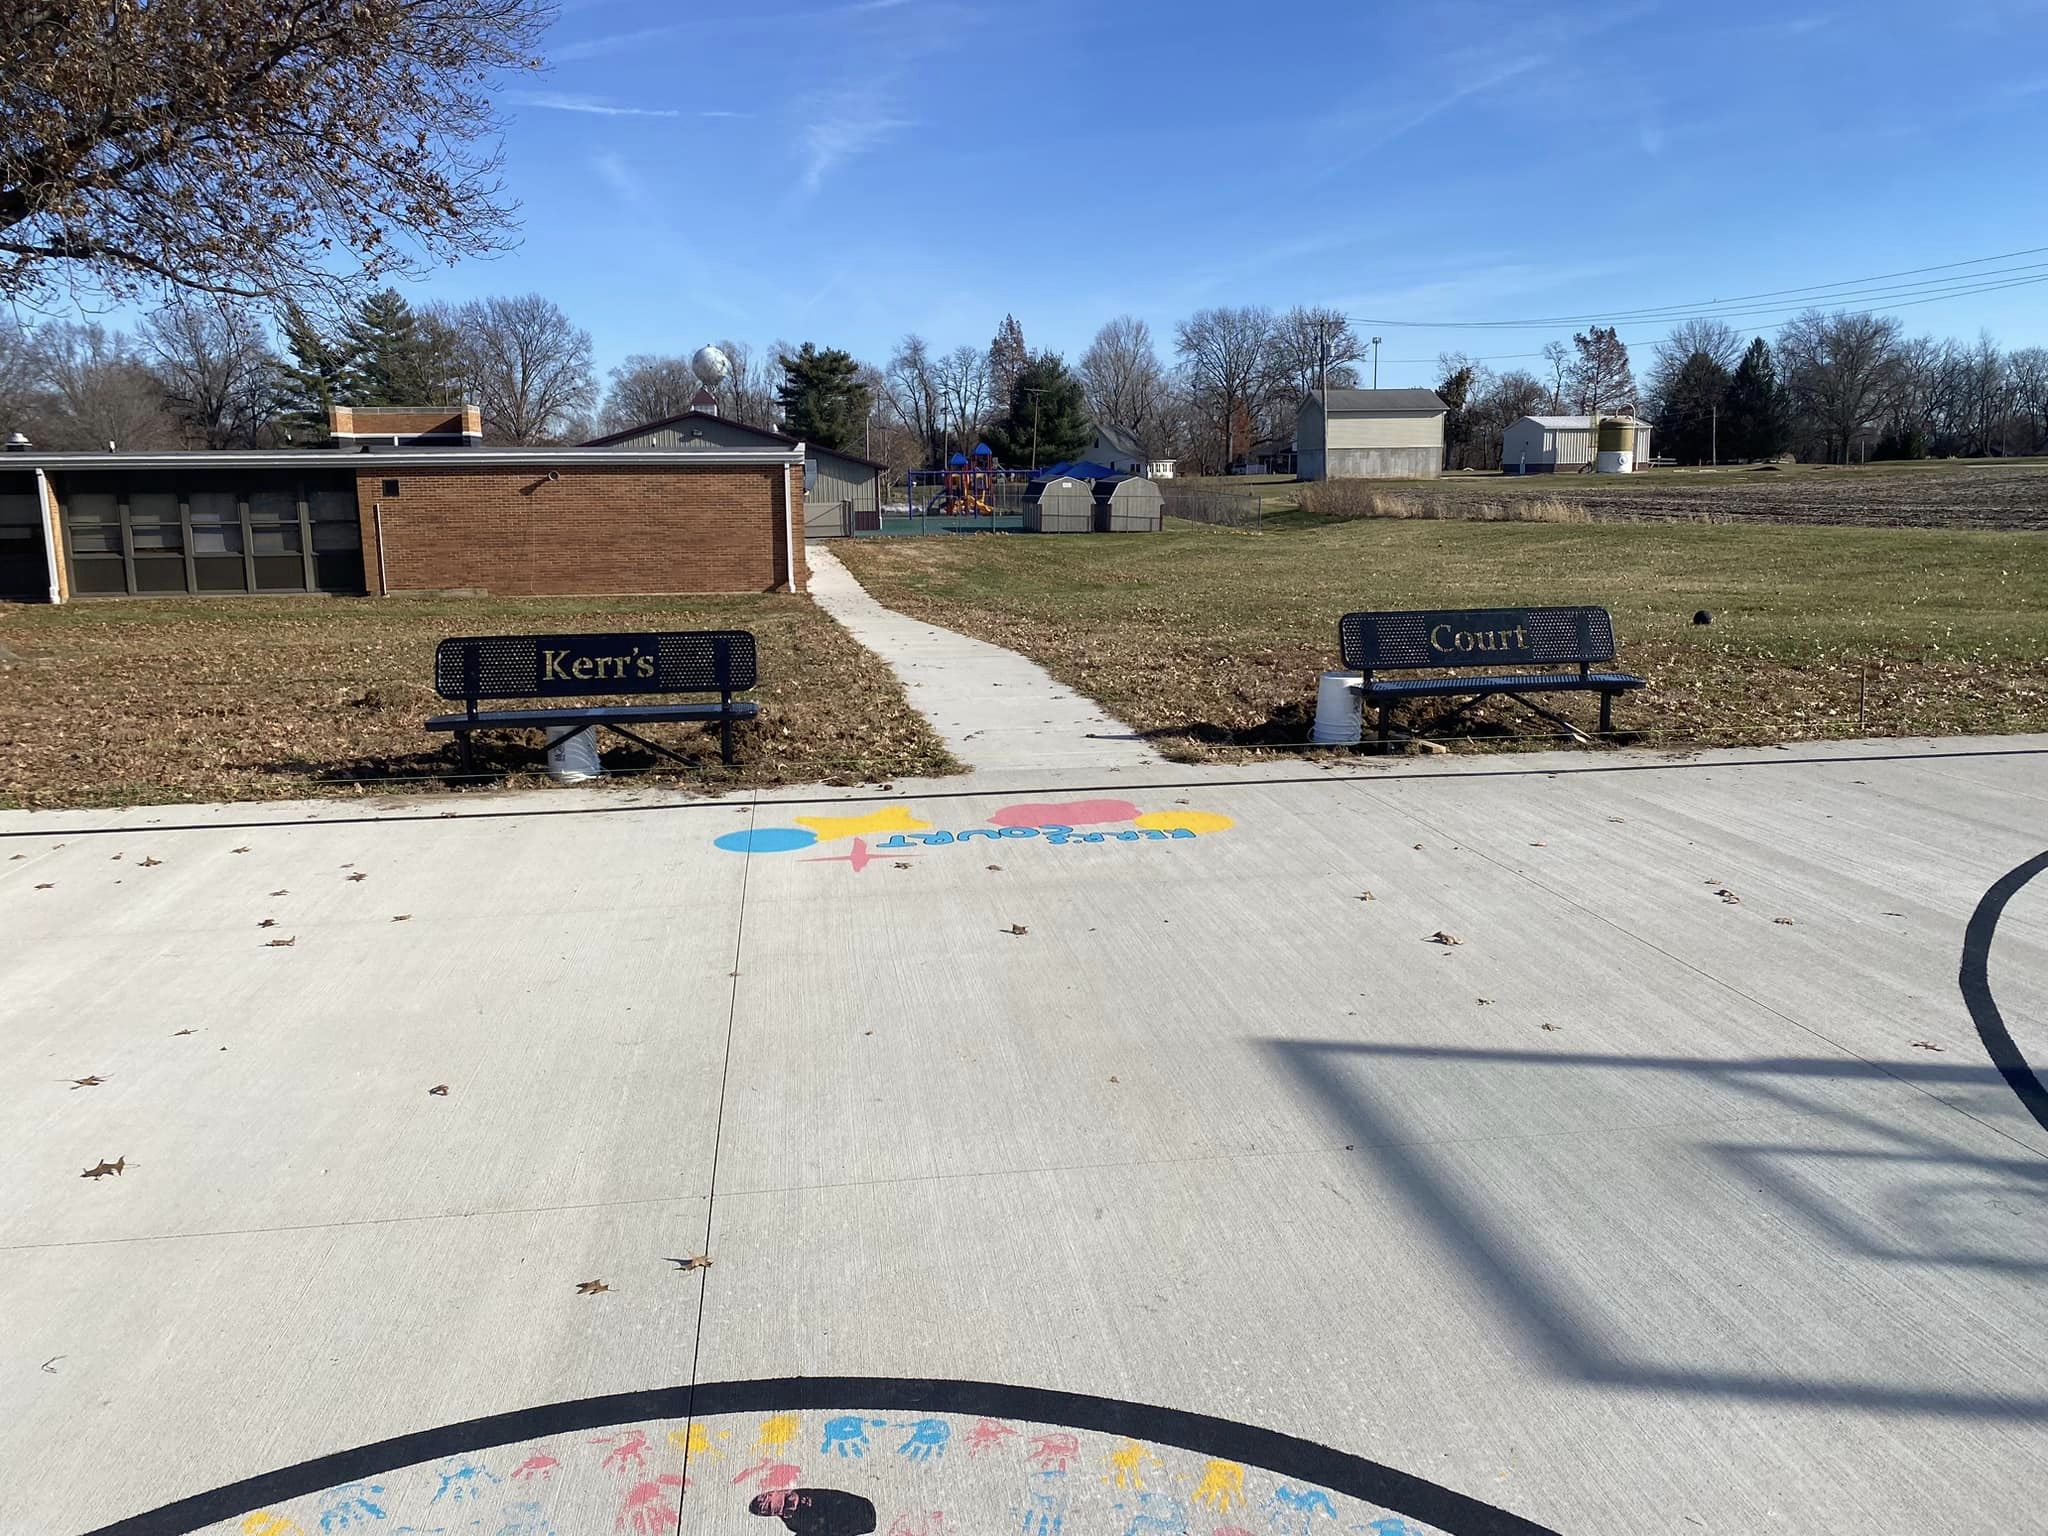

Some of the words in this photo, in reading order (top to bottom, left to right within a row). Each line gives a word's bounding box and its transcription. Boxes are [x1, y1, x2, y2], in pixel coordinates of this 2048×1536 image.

[1430, 623, 1531, 653] Court
[542, 647, 656, 681] Kerr's
[875, 825, 1073, 849] COURT
